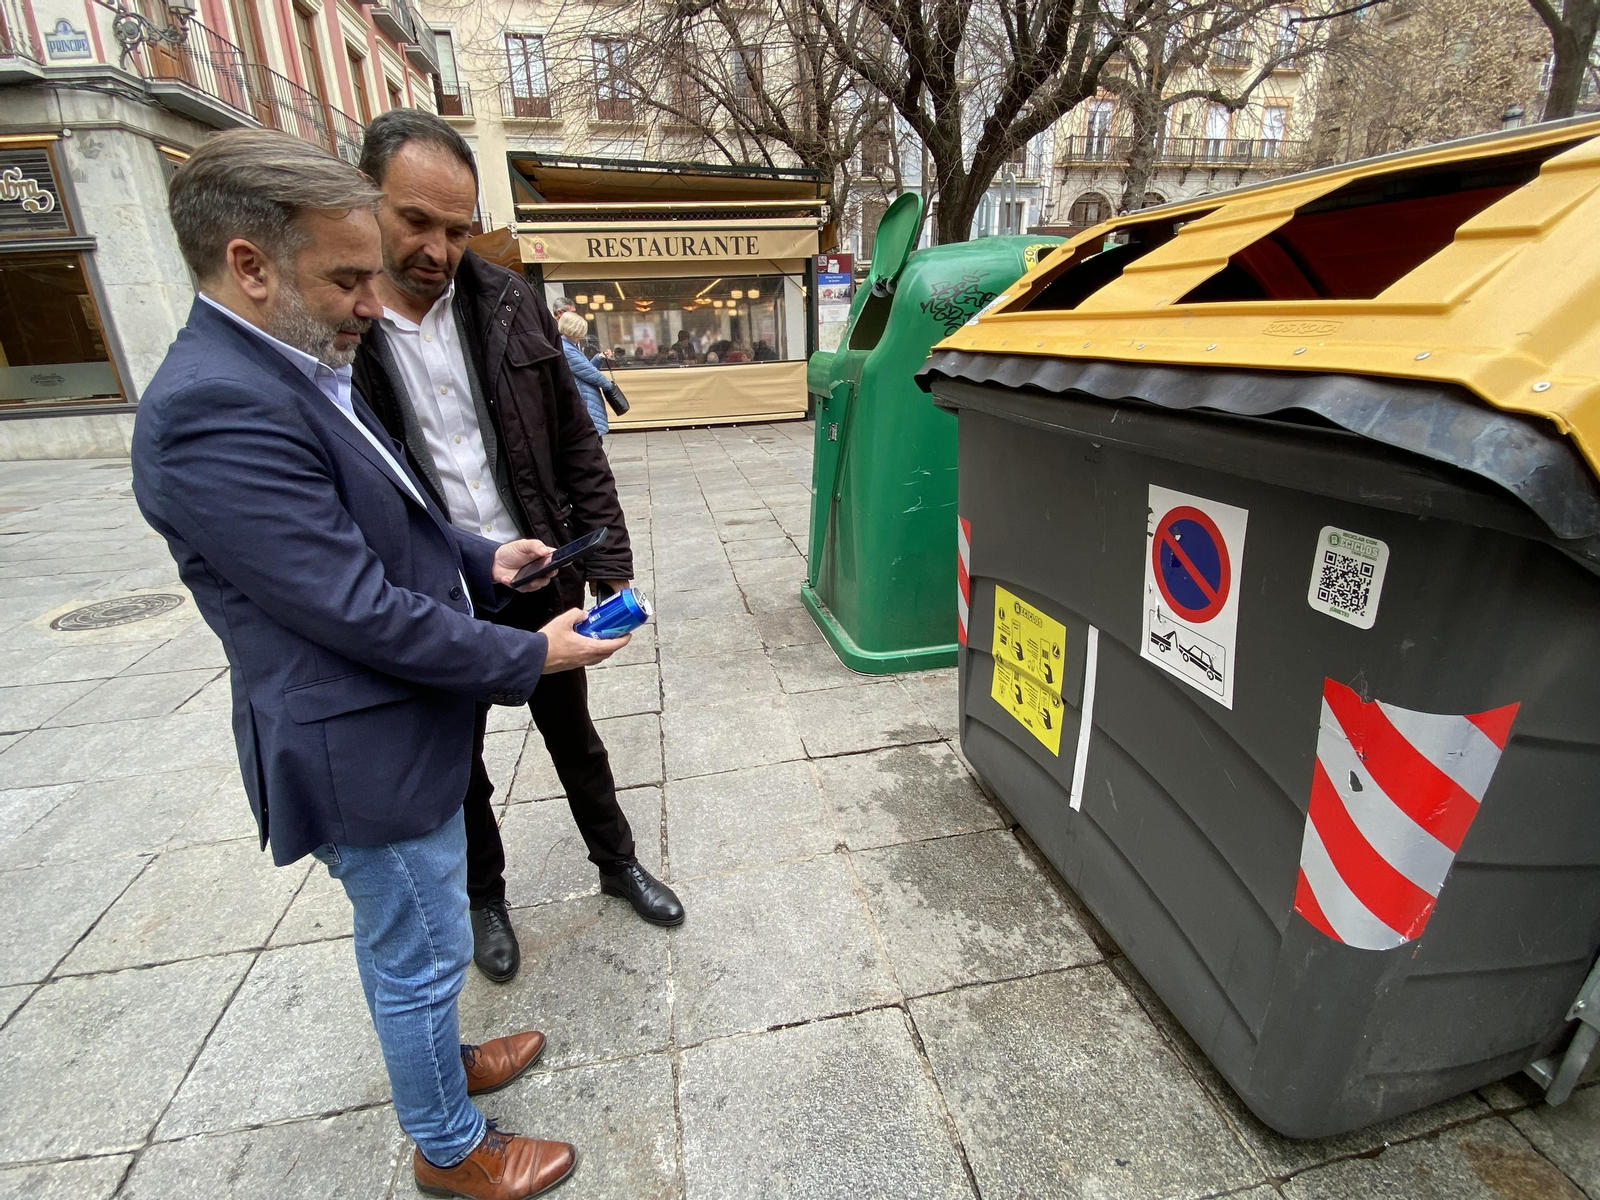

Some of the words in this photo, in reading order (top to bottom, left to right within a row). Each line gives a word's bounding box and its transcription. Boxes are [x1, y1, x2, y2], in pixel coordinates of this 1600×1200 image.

[586, 235, 760, 258] RESTAURANTE
[1328, 532, 1379, 557] RECICLOS
[1343, 532, 1364, 542] RECICLAR
